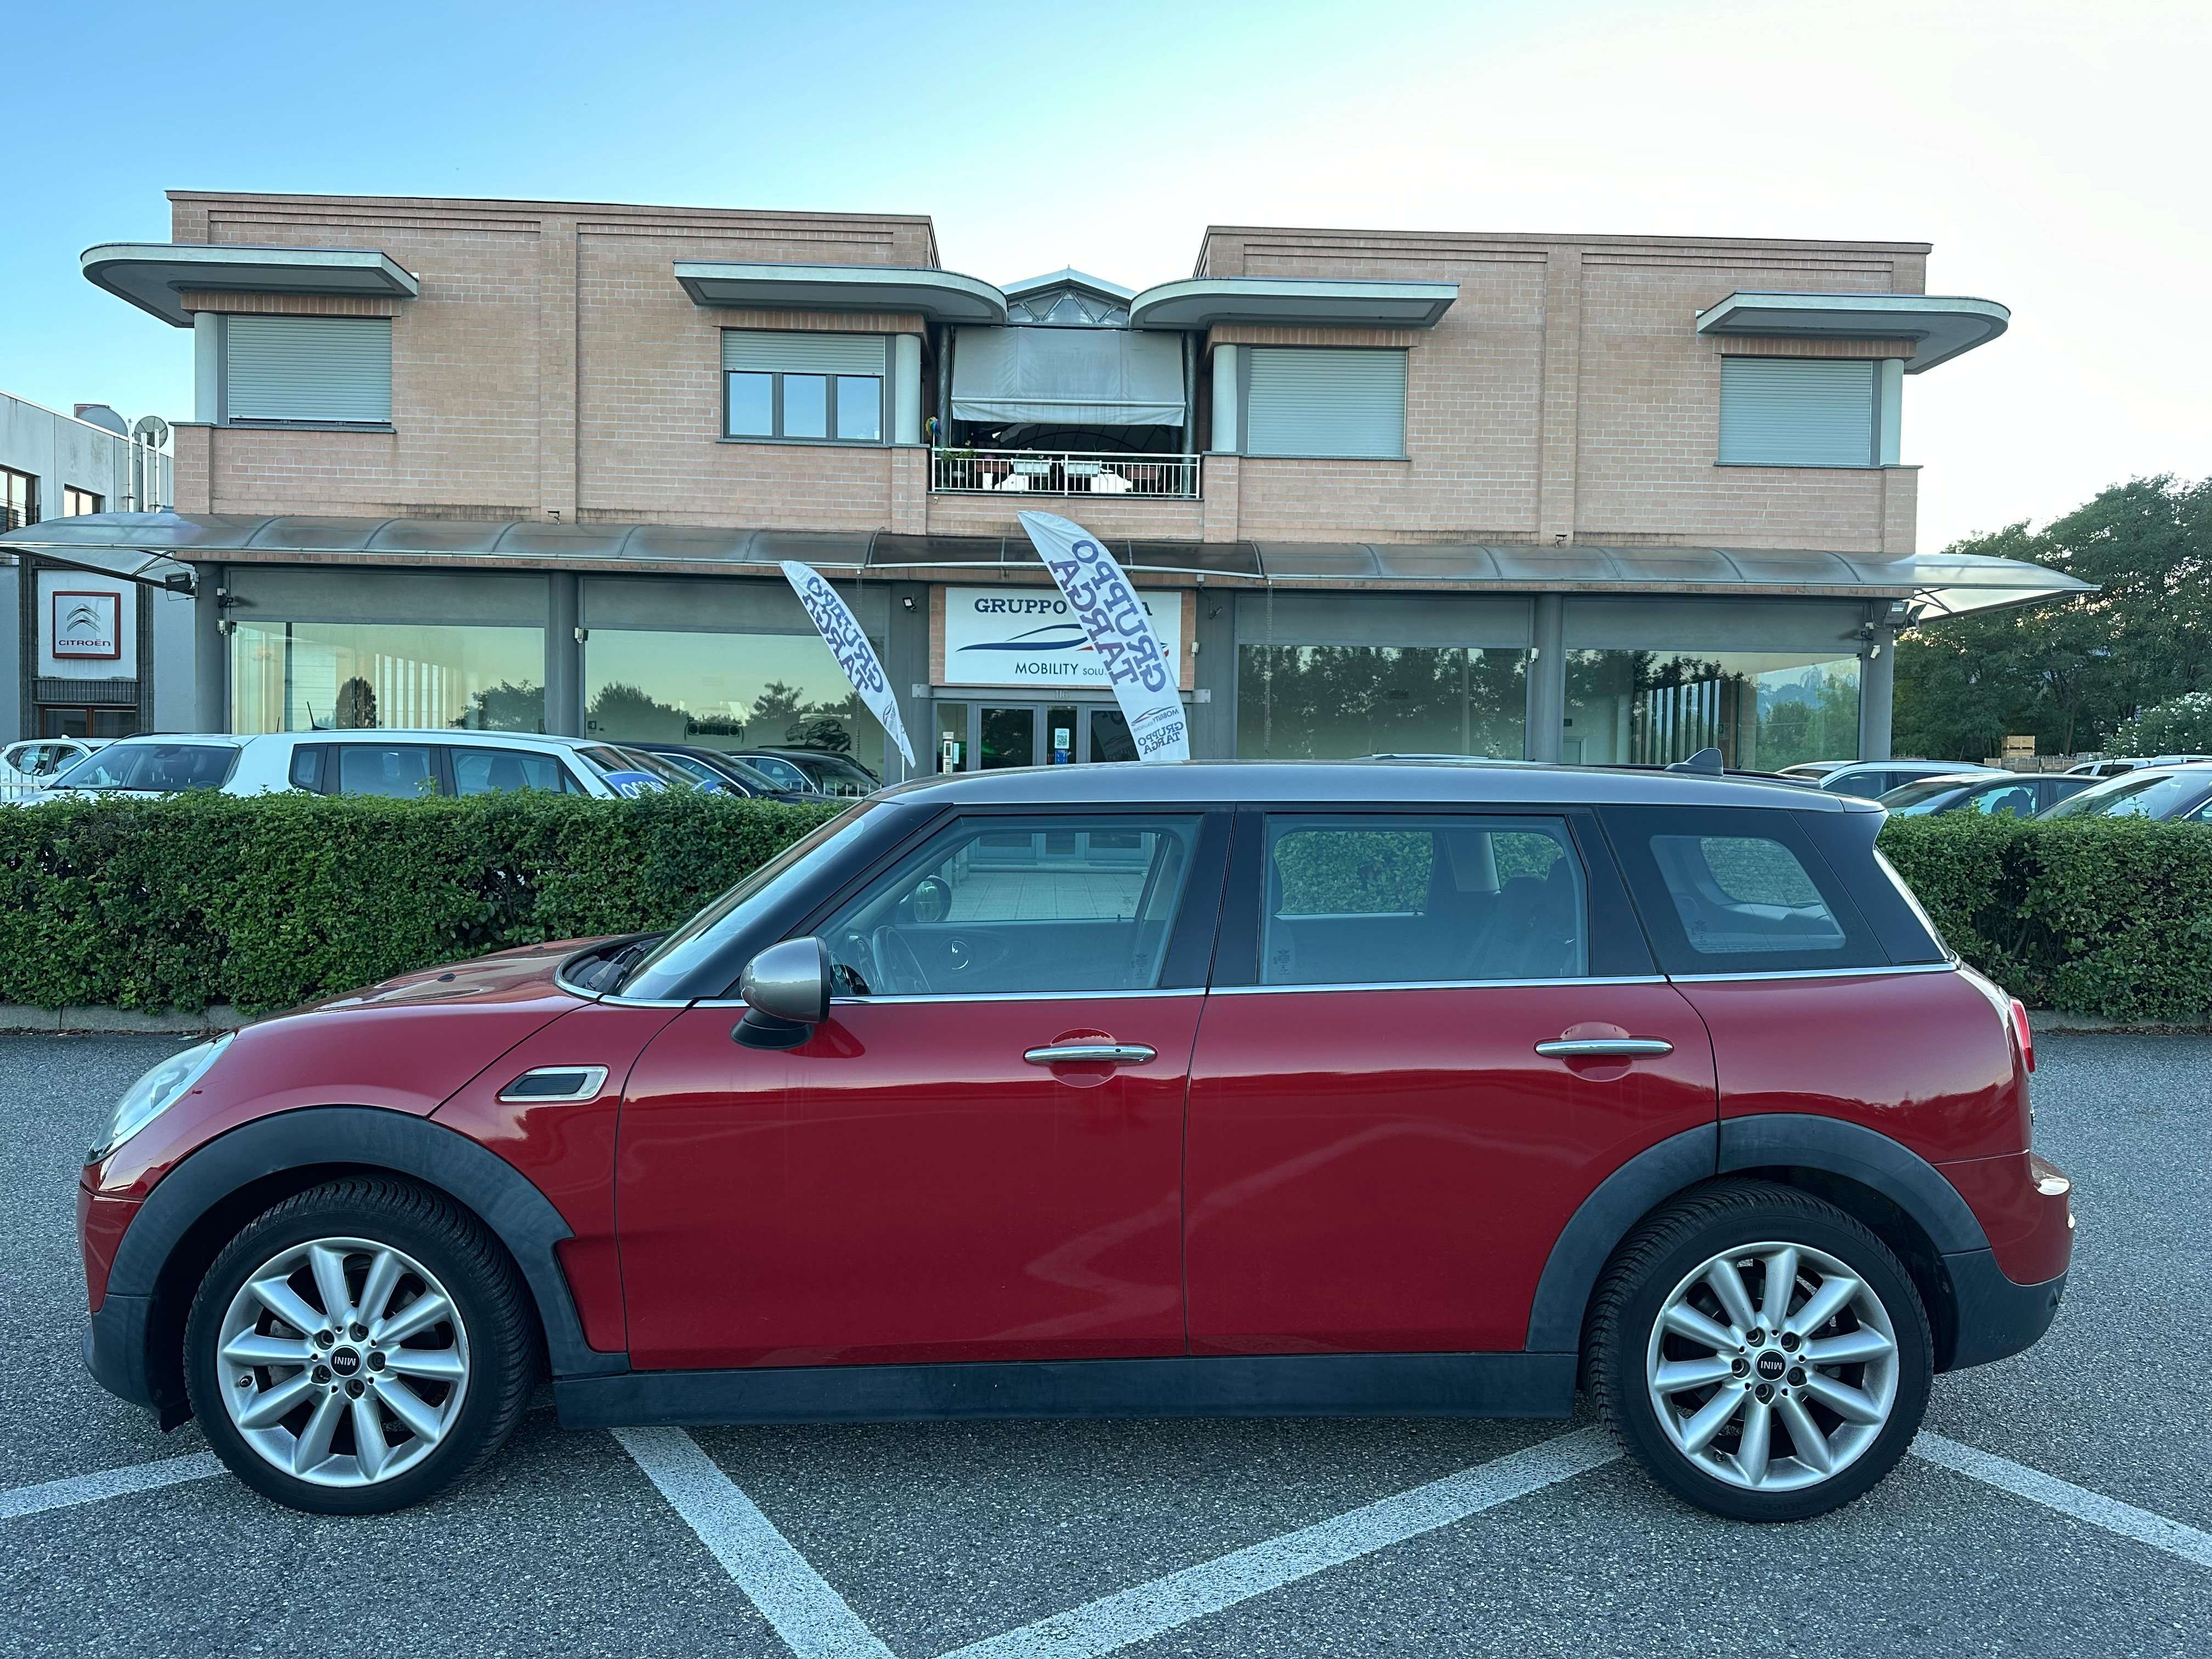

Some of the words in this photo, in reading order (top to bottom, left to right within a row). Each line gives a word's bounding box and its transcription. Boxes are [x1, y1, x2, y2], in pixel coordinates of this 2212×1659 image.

[974, 598, 1067, 614] GRUPPO
[1014, 662, 1079, 675] MOBILITY
[334, 1356, 356, 1366] MINI
[1760, 1361, 1782, 1370] MINI
